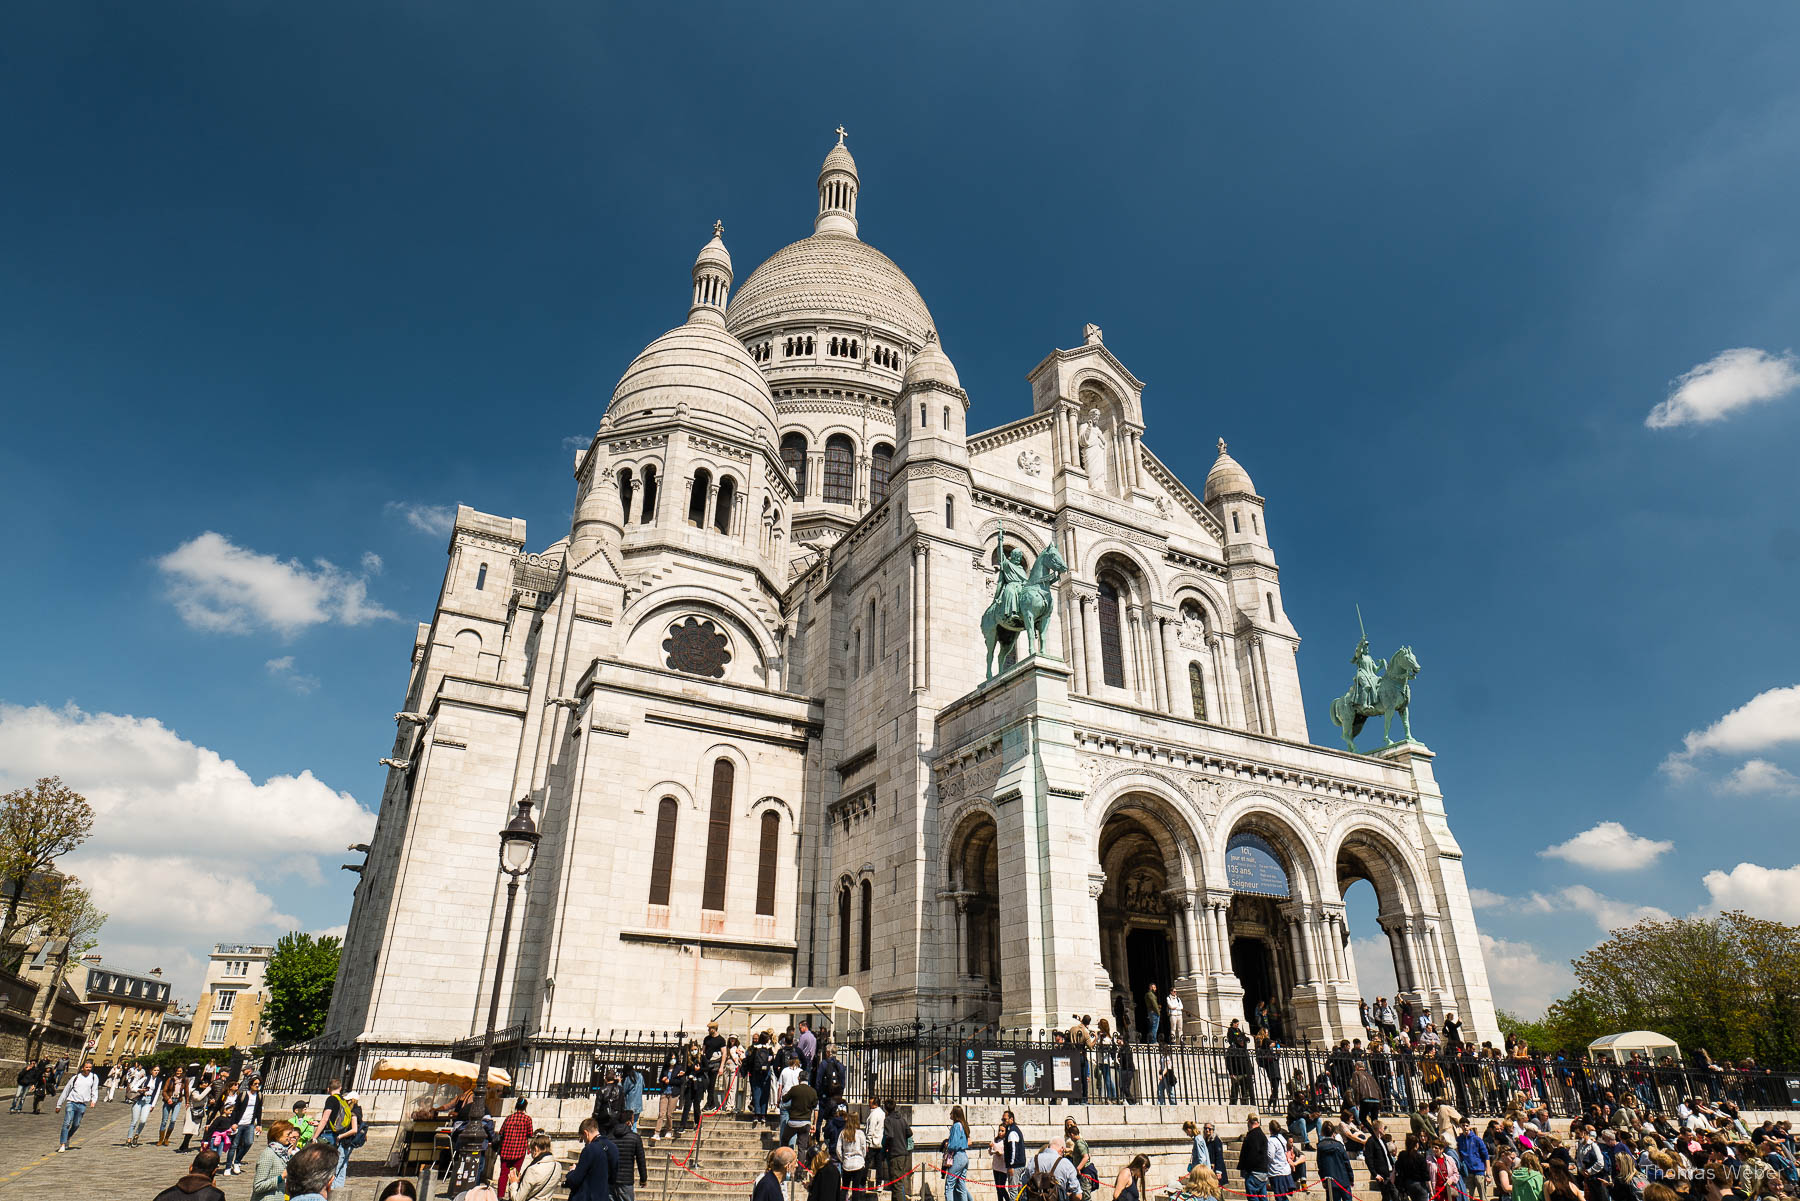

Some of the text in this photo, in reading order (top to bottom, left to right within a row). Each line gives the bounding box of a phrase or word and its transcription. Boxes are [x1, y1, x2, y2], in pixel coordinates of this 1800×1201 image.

[1227, 864, 1239, 874] 135
[1240, 867, 1254, 877] ans,
[1231, 878, 1258, 889] Seigneur
